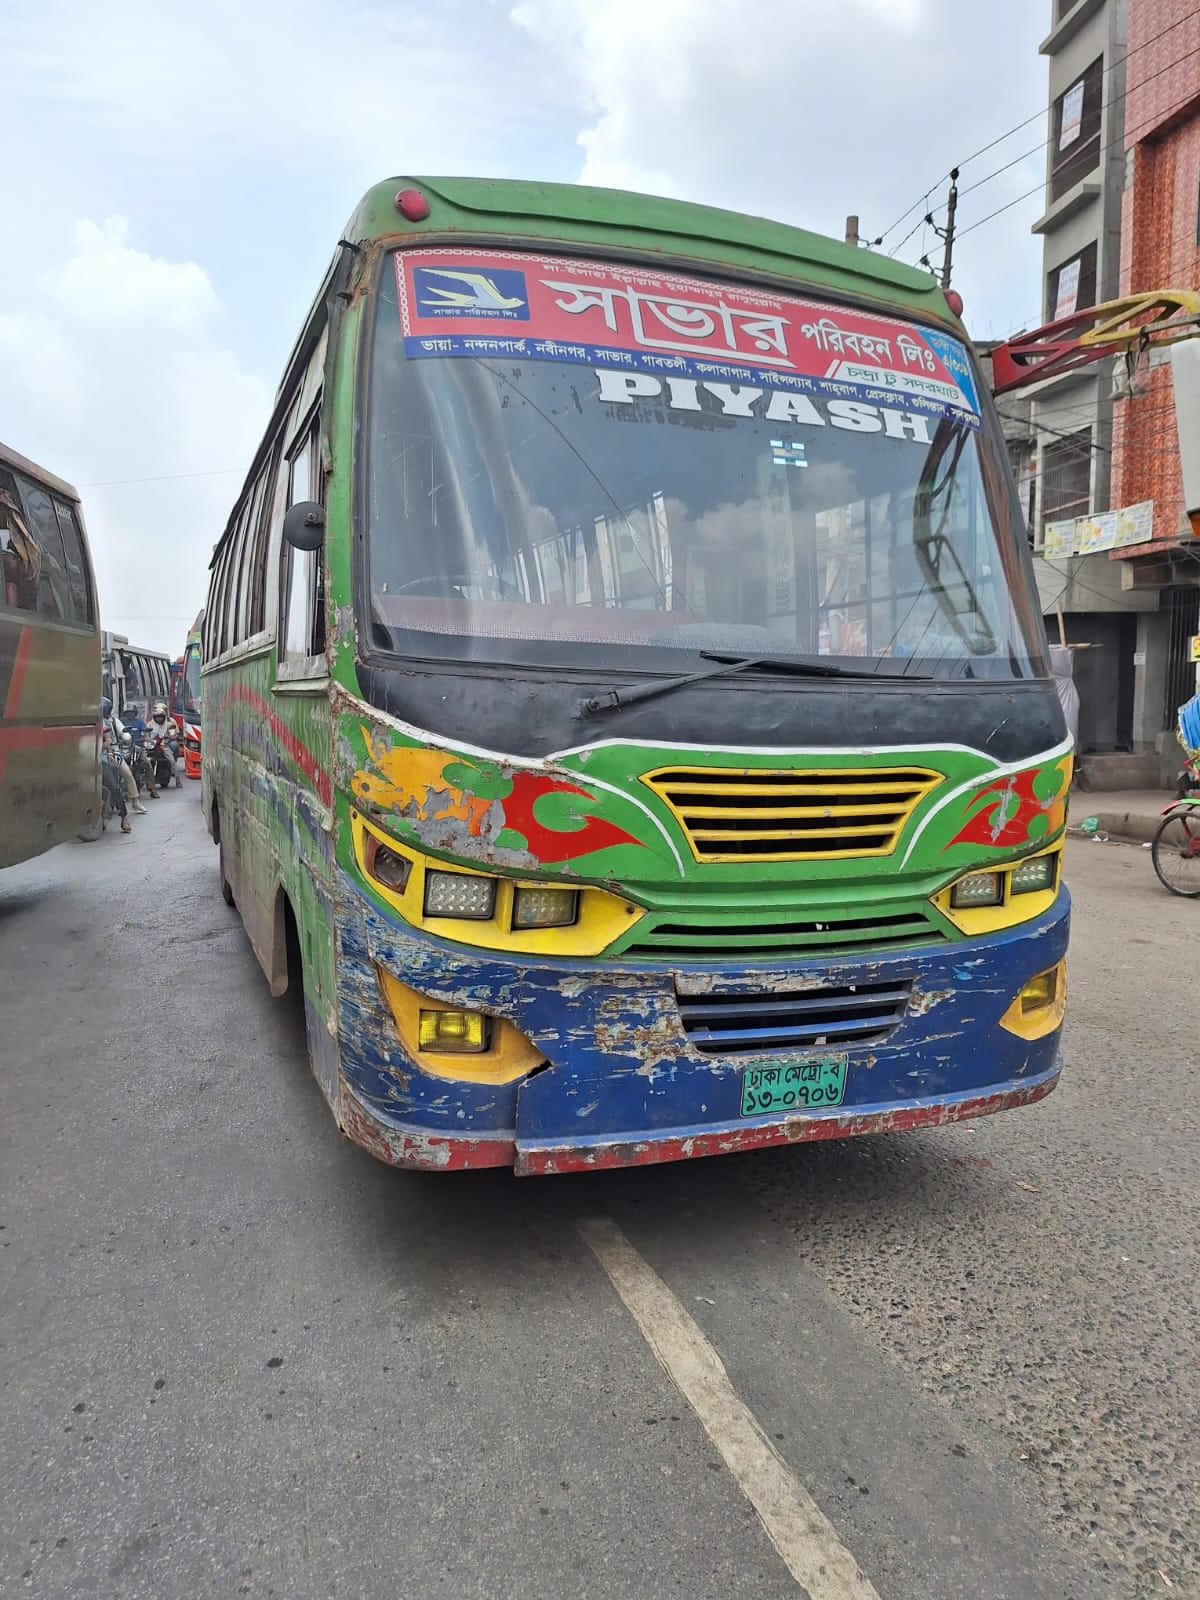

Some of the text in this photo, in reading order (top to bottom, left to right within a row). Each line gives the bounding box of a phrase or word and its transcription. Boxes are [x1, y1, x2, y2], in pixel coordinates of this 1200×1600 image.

[538, 280, 798, 368] সাভার
[801, 319, 893, 366] পরিবহন
[896, 334, 936, 373] লিঃ
[464, 339, 531, 355] নন্দনপার্ক,
[536, 341, 592, 361] নবীনগর,
[596, 350, 637, 366] সাভার,
[642, 355, 692, 374] গাবতলী,
[696, 362, 756, 383] কলাবাগান,
[595, 367, 933, 444] PIYASH
[903, 376, 960, 400] সদরঘাট
[749, 1068, 783, 1087] ঢাকা
[746, 1083, 839, 1112] ১৩-০৭০৬
